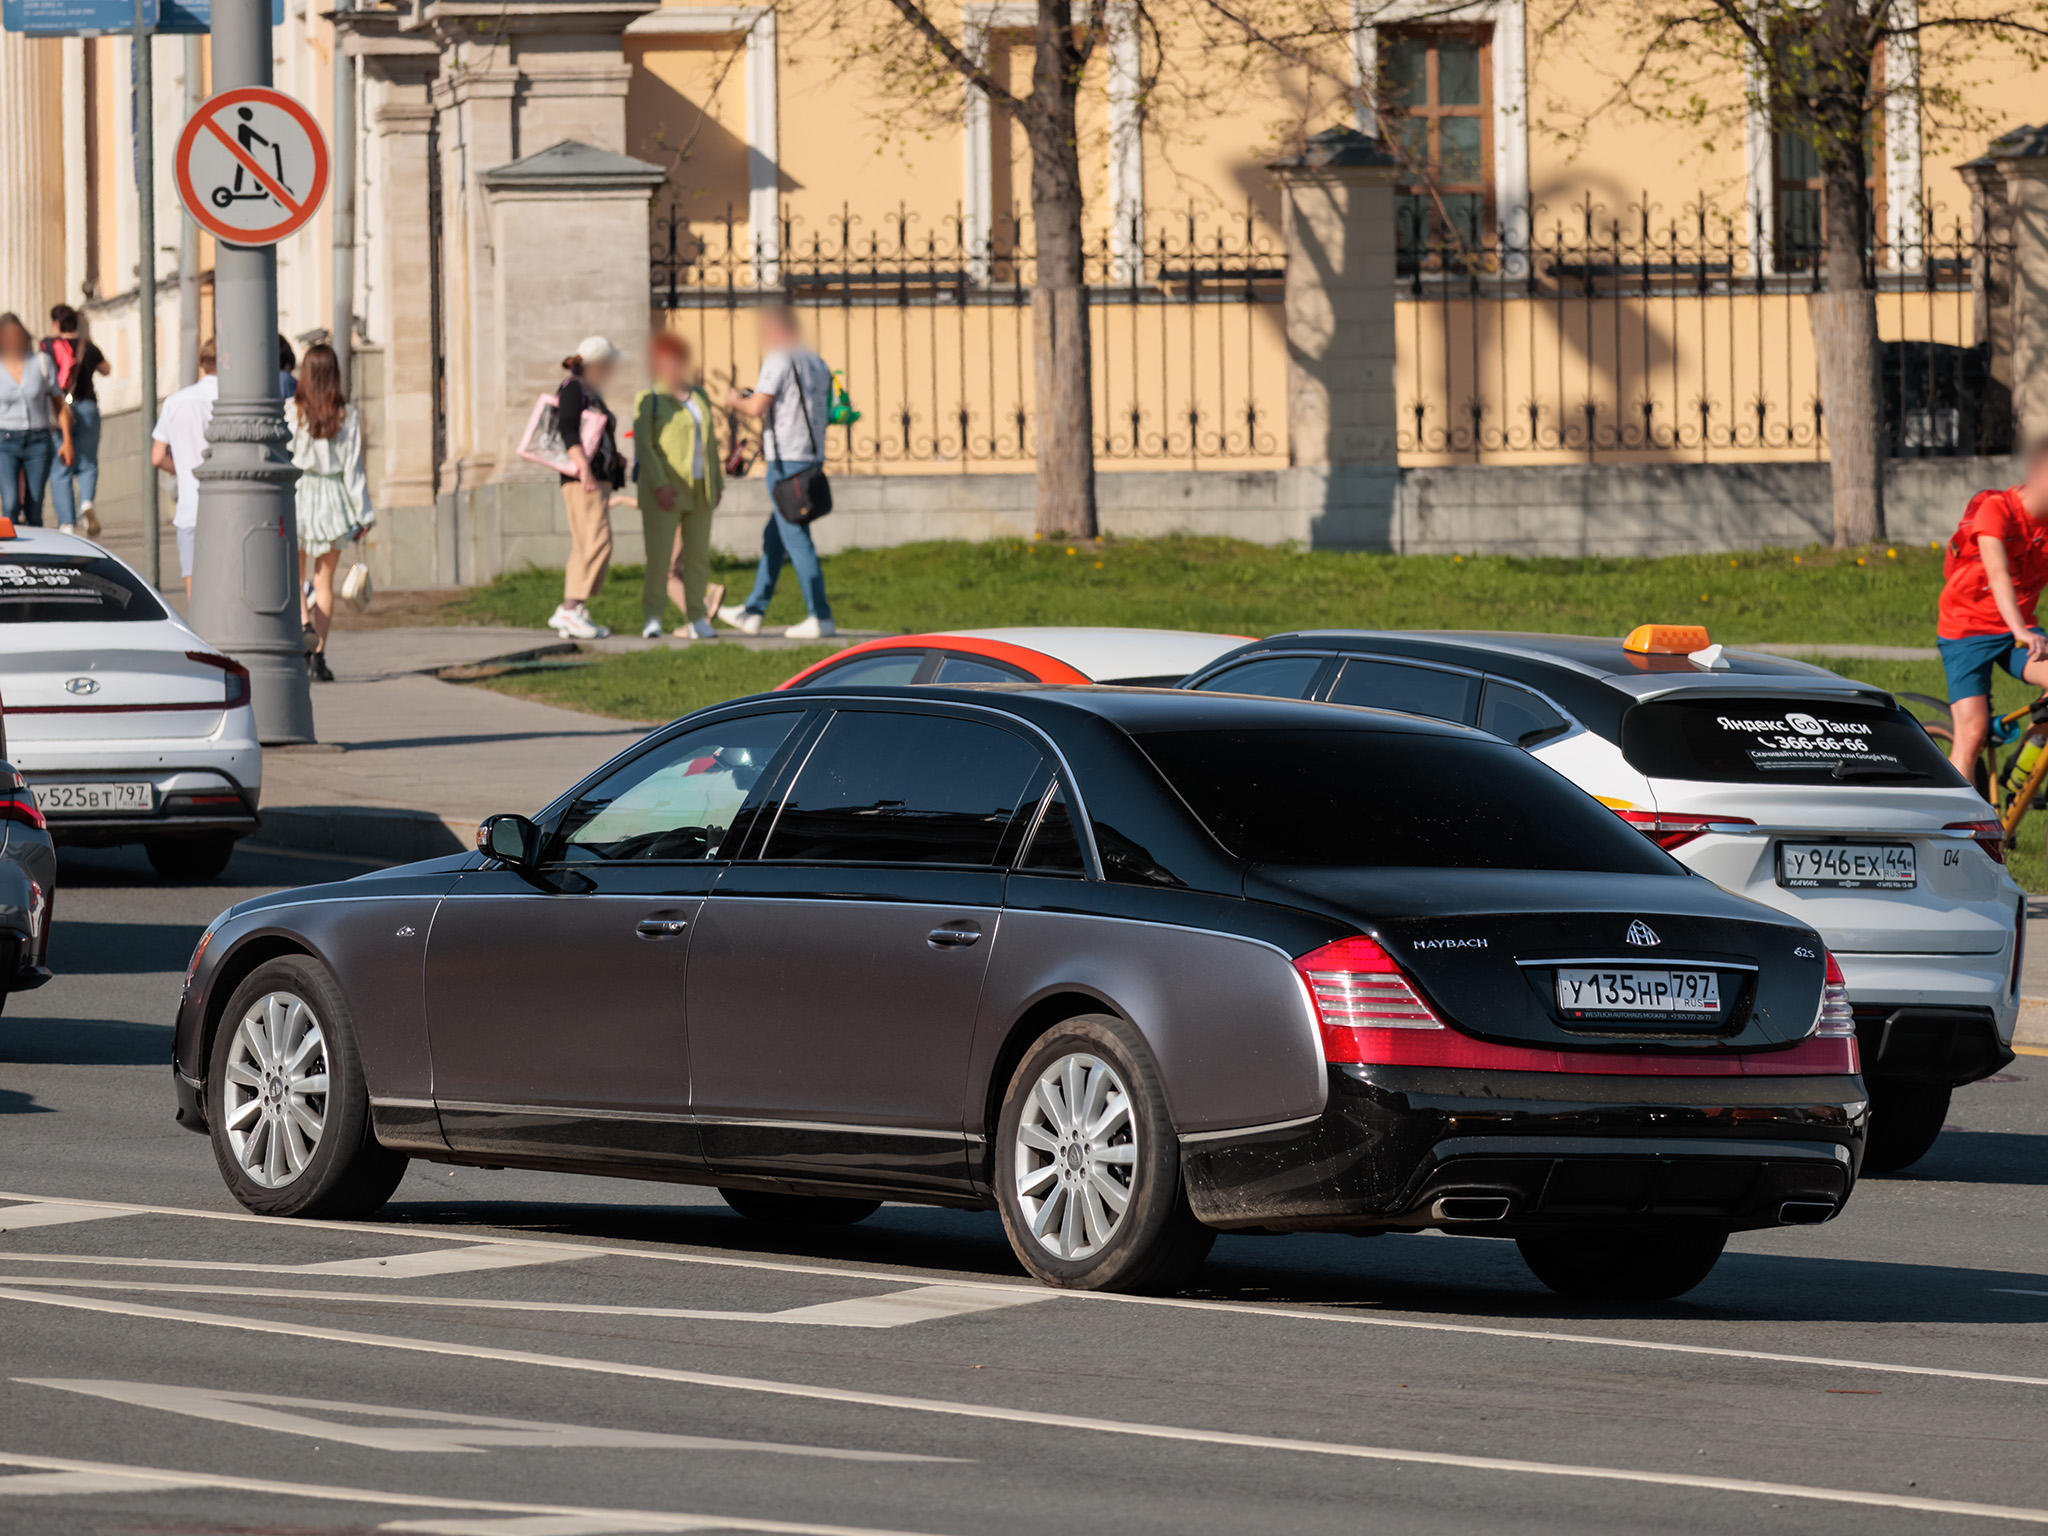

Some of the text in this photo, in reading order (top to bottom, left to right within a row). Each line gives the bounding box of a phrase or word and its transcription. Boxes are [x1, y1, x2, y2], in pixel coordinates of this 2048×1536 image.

[25, 566, 81, 577] Такси
[0, 575, 70, 586] -99-99
[1716, 716, 1873, 735] Яндекс Go Такси
[1774, 735, 1869, 752] 366-66-66
[116, 785, 145, 801] 797
[1886, 849, 1907, 870] 44
[1885, 869, 1900, 877] RUS
[1789, 879, 1819, 887] HAVAL
[1413, 938, 1488, 950] MAYBACH
[1793, 946, 1815, 959] 62S
[1673, 974, 1710, 999] 797
[1684, 998, 1703, 1008] RUS
[1612, 1011, 1643, 1019] AUTOHAUS
[1643, 1012, 1667, 1020] MOSKAU
